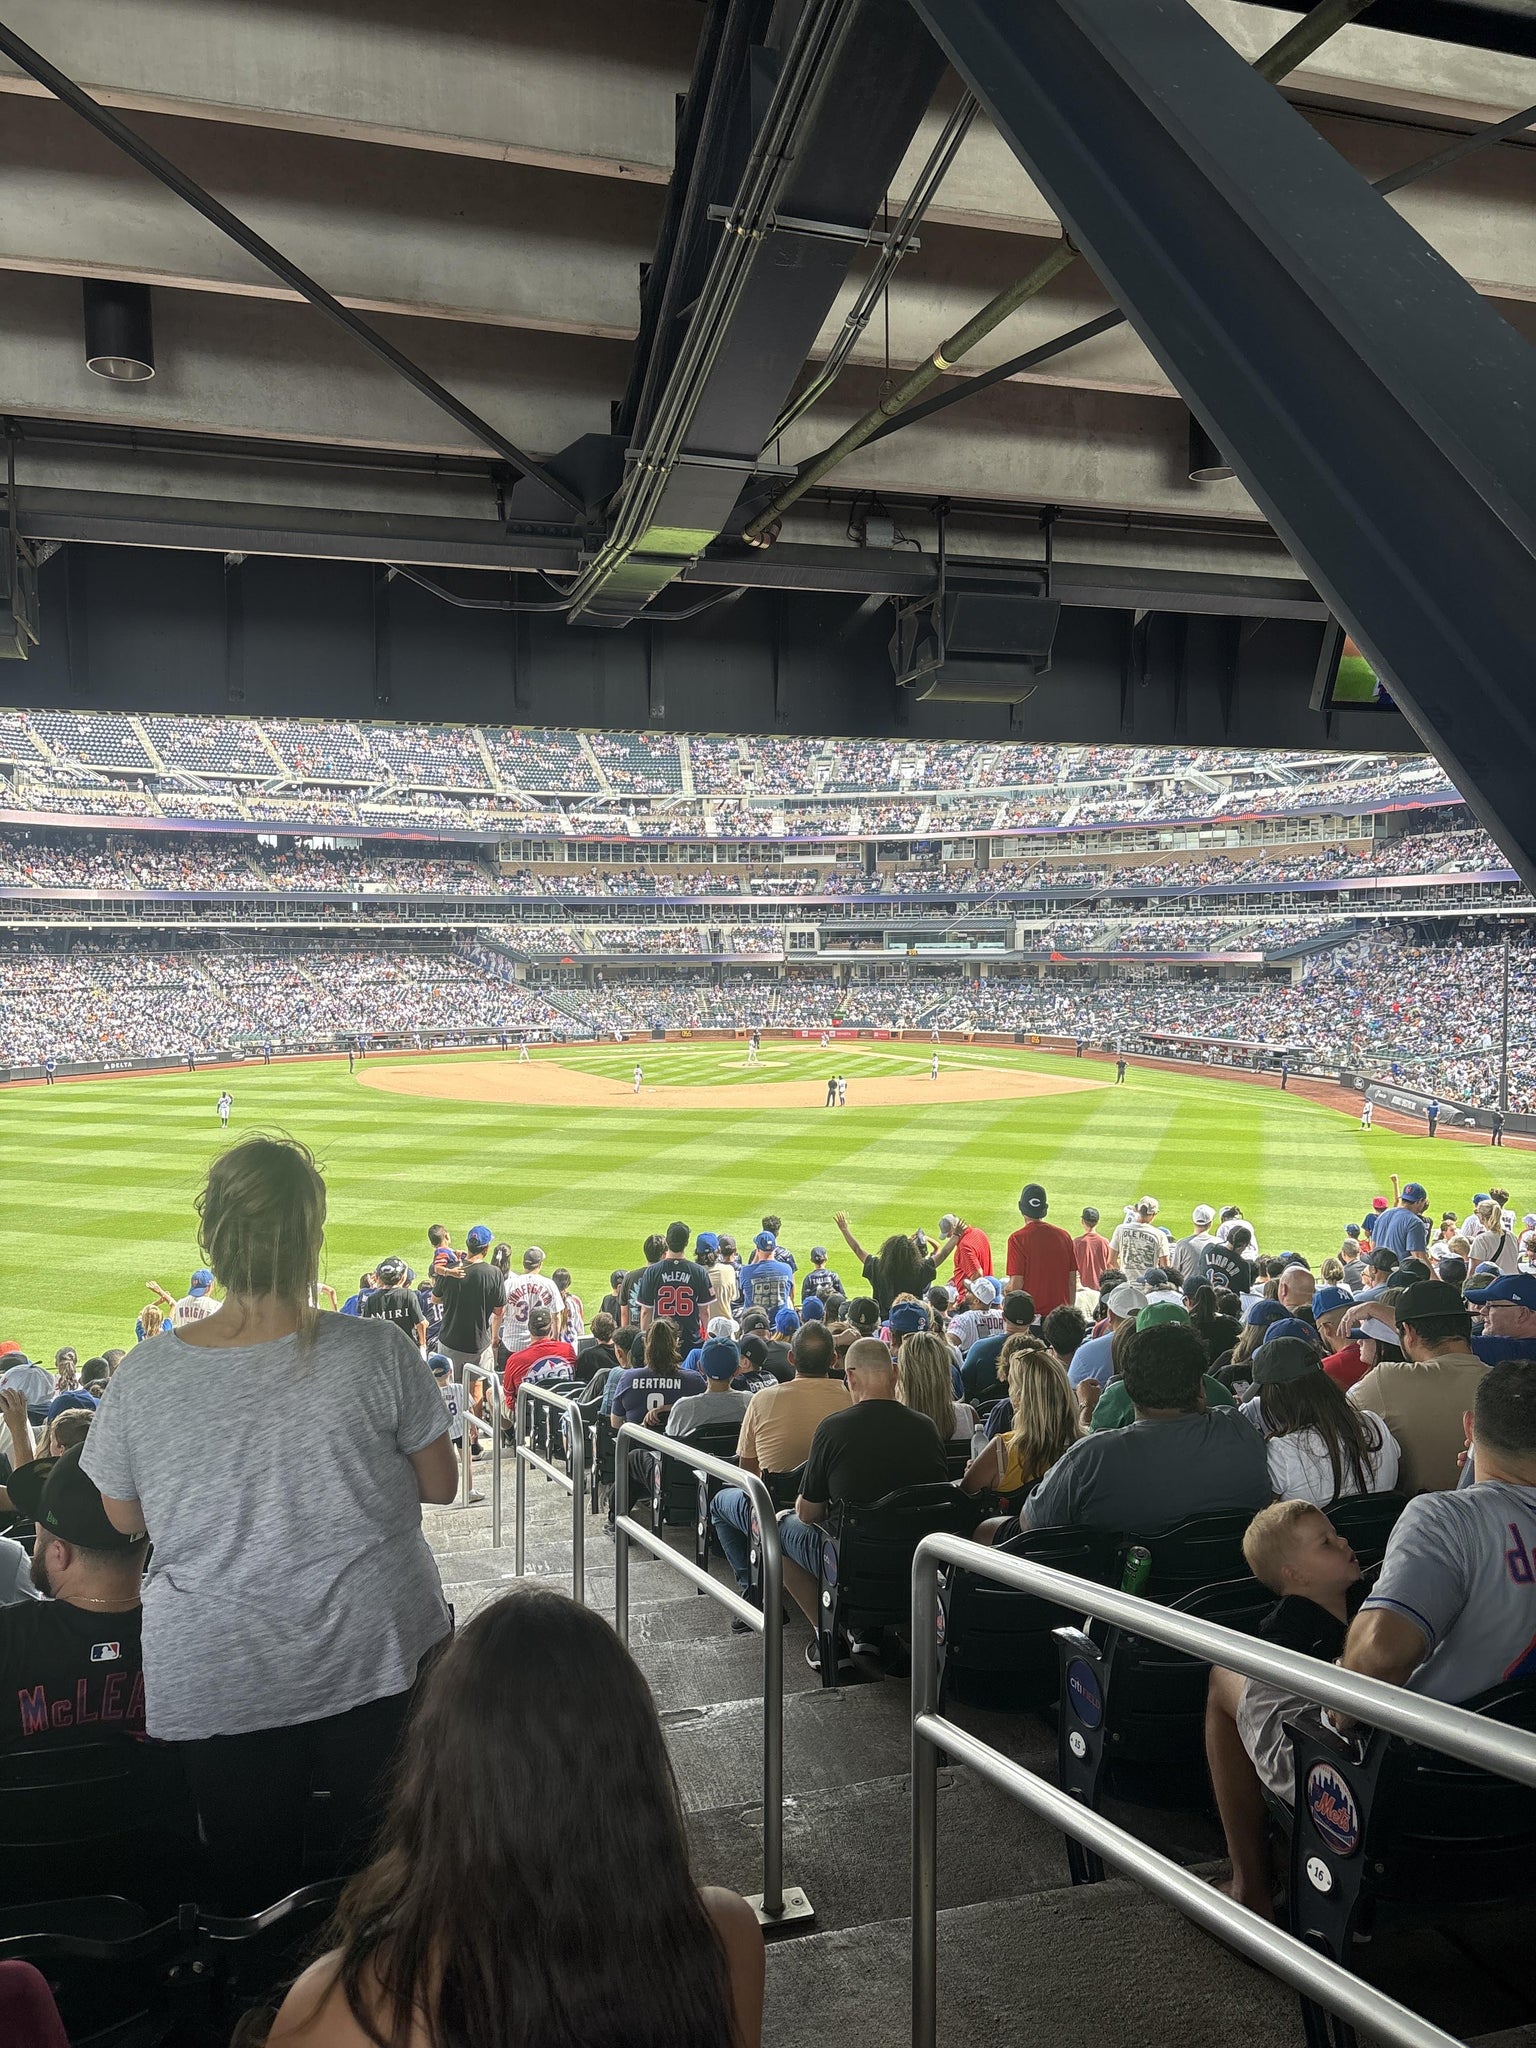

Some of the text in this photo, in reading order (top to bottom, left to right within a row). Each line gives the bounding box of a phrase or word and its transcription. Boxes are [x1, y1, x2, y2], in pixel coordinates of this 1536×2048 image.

[111, 1061, 133, 1069] DELTA
[1029, 1198, 1040, 1207] C
[661, 1271, 691, 1284] McLEAN
[657, 1285, 694, 1317] 26
[632, 1377, 682, 1390] BERTRON
[1504, 1522, 1536, 1585] d
[1313, 1791, 1351, 1833] Mets
[1314, 1866, 1325, 1882] 16
